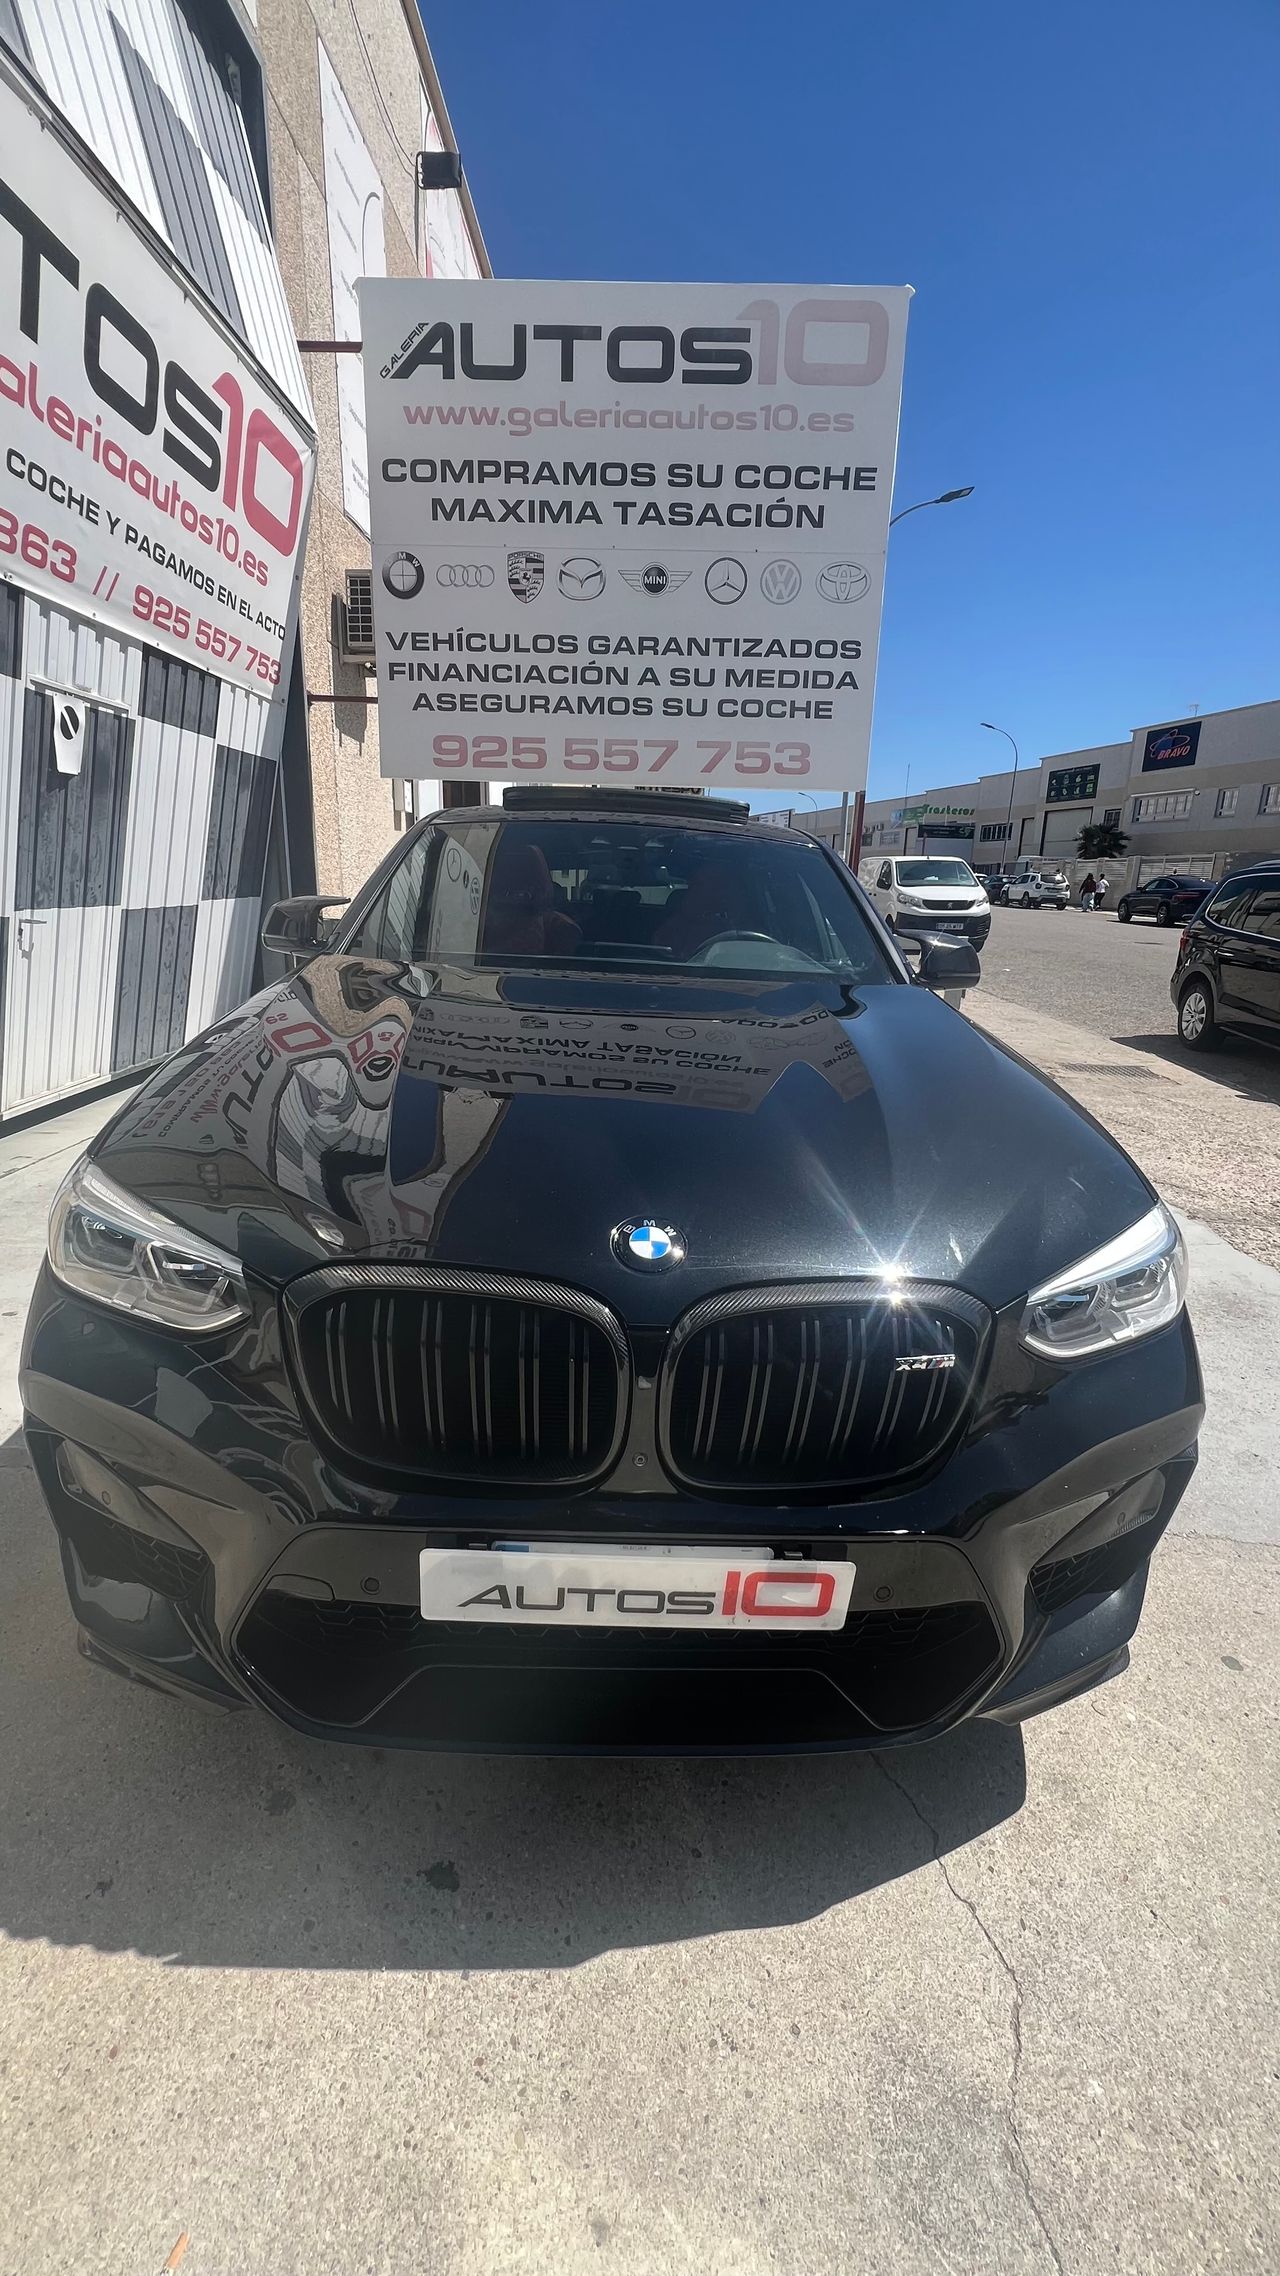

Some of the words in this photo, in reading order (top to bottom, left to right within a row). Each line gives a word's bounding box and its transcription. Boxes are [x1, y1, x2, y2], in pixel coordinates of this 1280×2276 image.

[379, 321, 430, 380] GALERIA
[402, 401, 855, 436] www.galeriaautos10.es
[381, 458, 656, 487] COMPRAMOS
[667, 463, 723, 489] SU
[734, 464, 878, 491] COCHE
[431, 498, 603, 525] MAXIMA
[613, 496, 825, 529] TASACIÓN
[7, 448, 100, 526] COCHE
[106, 510, 121, 535] Y
[125, 523, 215, 596] PAGAMOS
[217, 585, 237, 610] EN
[239, 599, 253, 621] EL
[255, 611, 286, 641] ACTO
[644, 575, 667, 586] MINI
[132, 585, 191, 640] 925
[195, 618, 242, 662] 557
[245, 645, 282, 686] 753
[385, 627, 579, 654] VEHÍCULOS
[587, 636, 862, 660] GARANTIZADOS
[388, 660, 629, 686] FINANCIACIÓN
[636, 667, 661, 686] A
[669, 667, 717, 688] SU
[726, 669, 860, 690] MEDIDA
[411, 693, 653, 716] ASEGURAMOS
[661, 696, 708, 718] SU
[717, 698, 833, 720] COCHE
[432, 735, 548, 770] 925
[563, 738, 680, 773] 557
[696, 740, 812, 776] 753
[1157, 745, 1191, 760] BRAVO
[623, 1219, 677, 1237] BMW
[457, 1570, 836, 1617] AUTOS10
